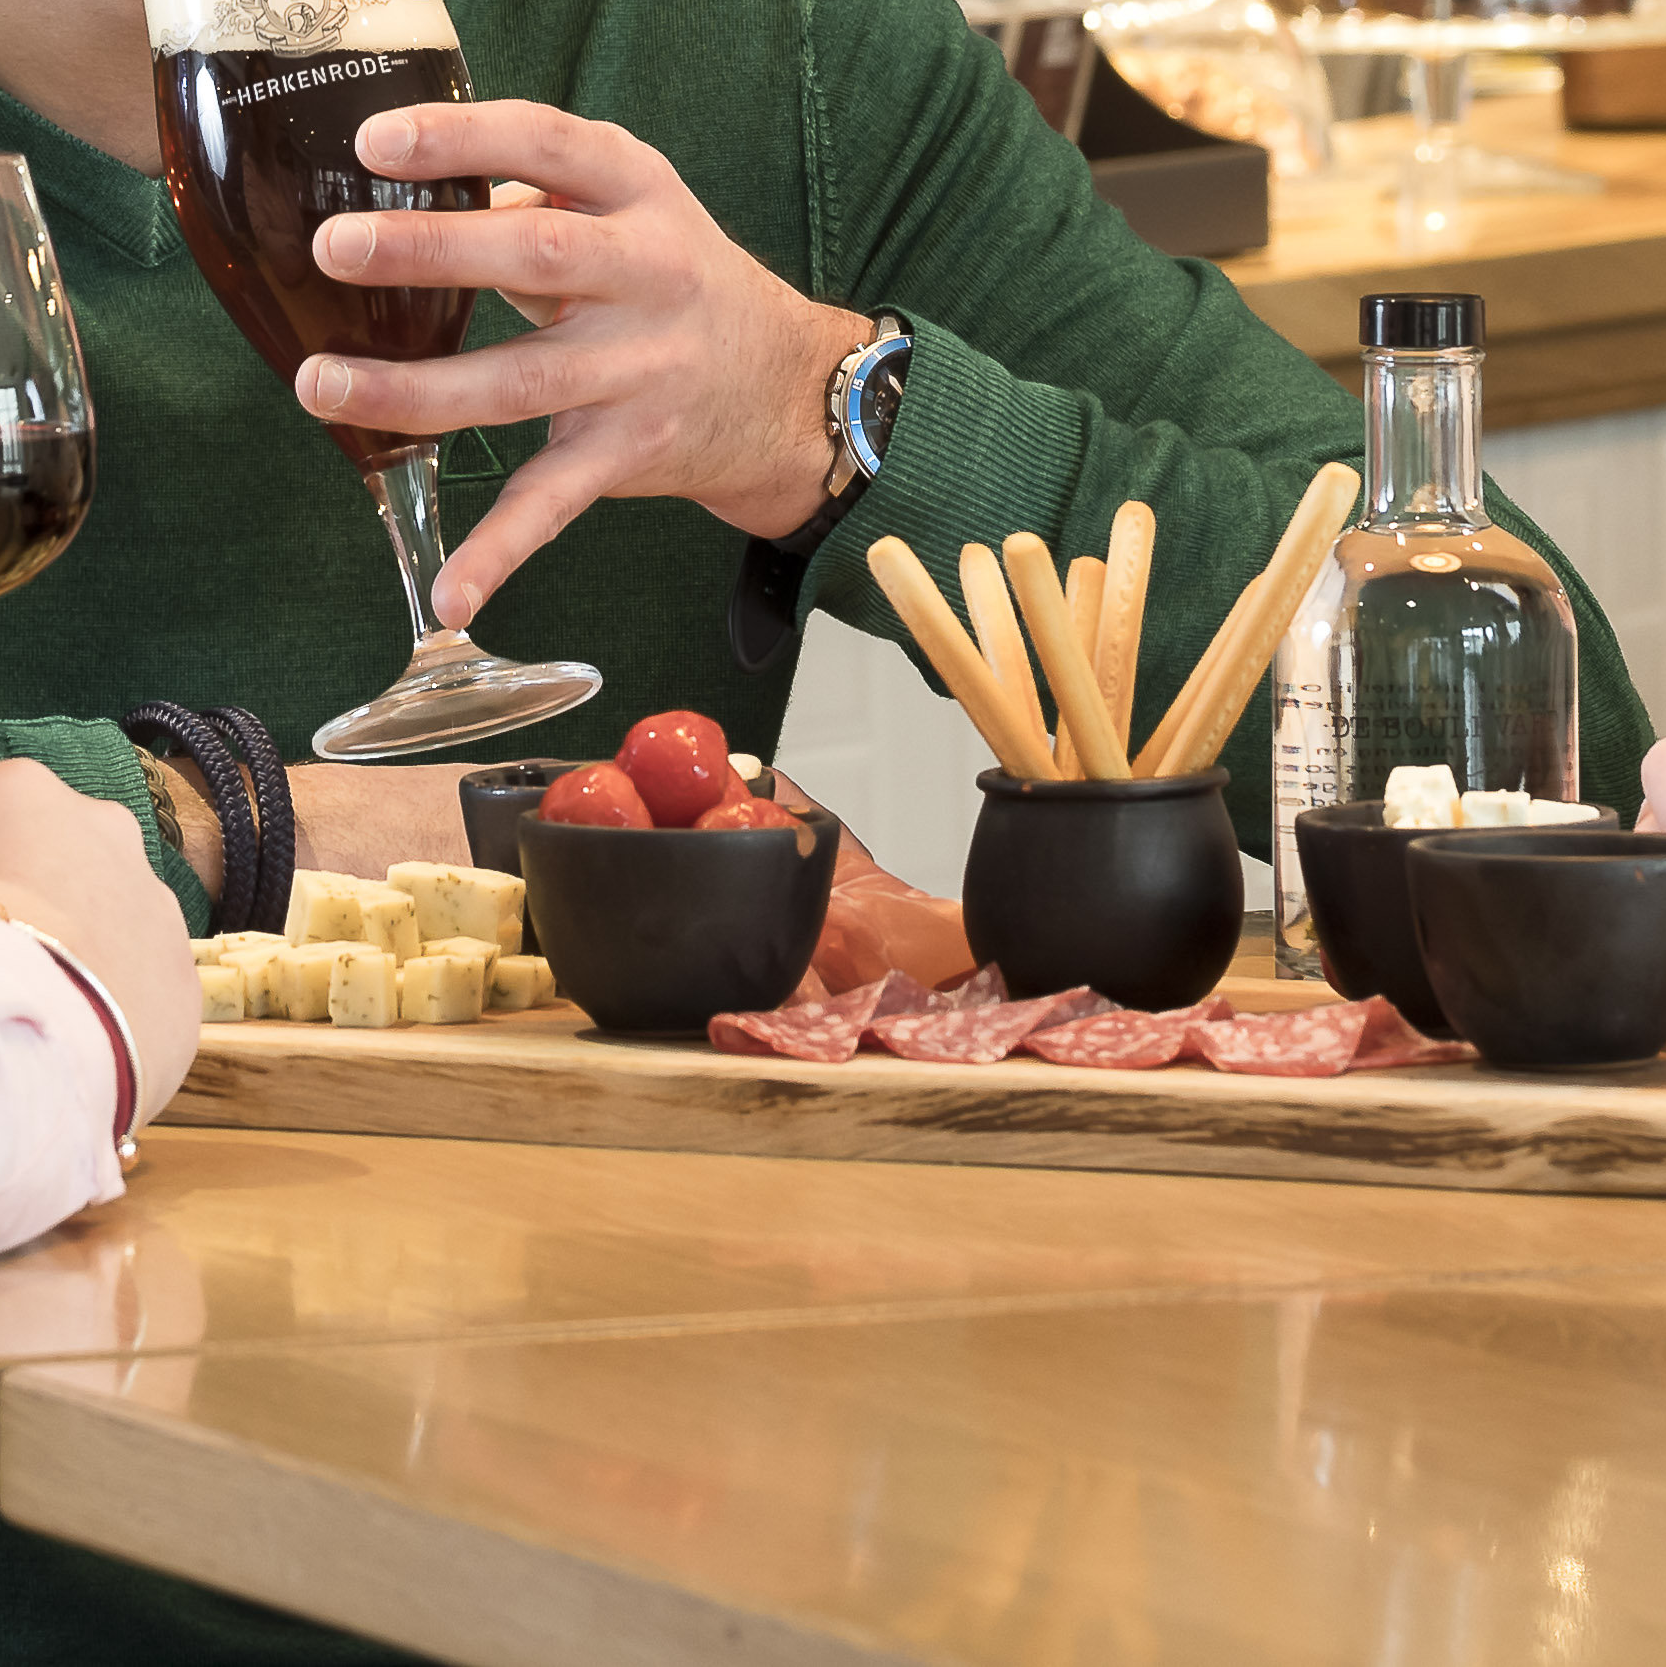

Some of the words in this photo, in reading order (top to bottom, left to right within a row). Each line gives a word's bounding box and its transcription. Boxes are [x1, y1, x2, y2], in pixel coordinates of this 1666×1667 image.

[237, 55, 392, 107] HERKENRODE
[852, 378, 865, 392] 15
[1331, 715, 1370, 739] DE
